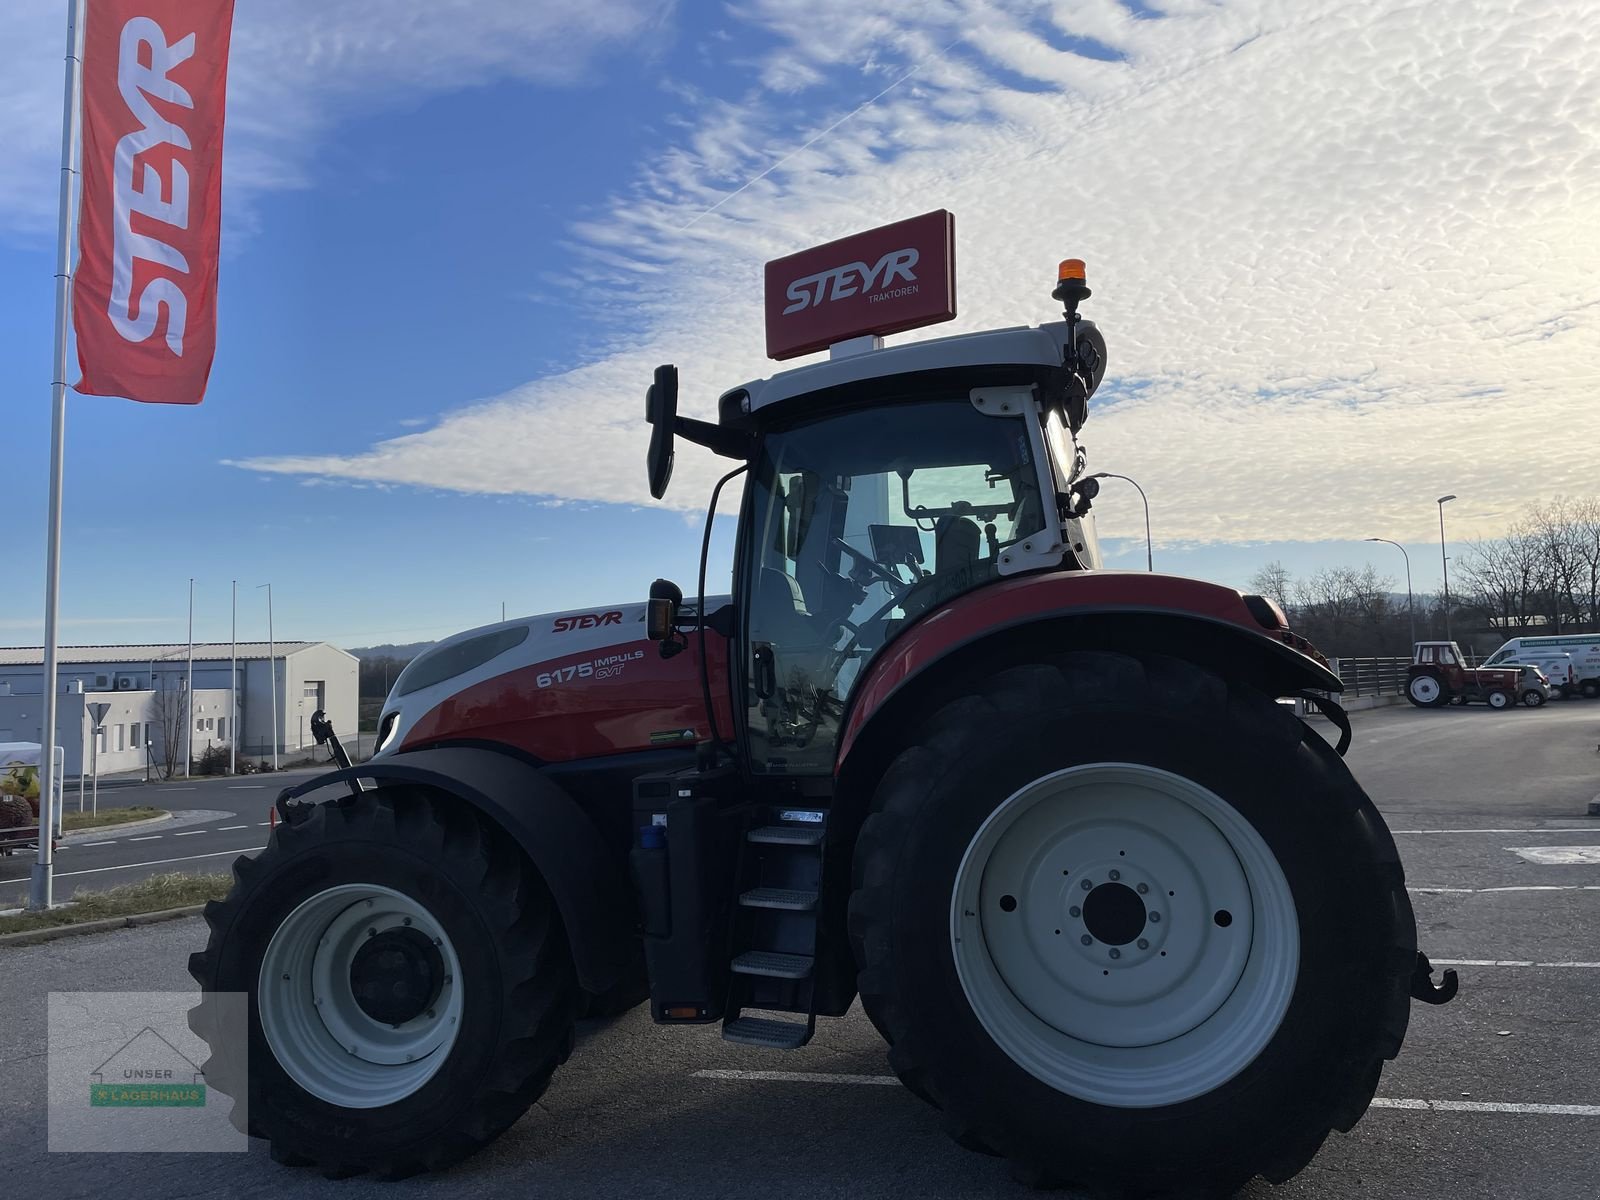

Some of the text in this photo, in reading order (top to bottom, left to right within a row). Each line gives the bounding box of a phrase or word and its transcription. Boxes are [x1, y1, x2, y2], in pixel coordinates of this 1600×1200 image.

[108, 16, 196, 357] STEYR
[782, 247, 920, 316] STEYR
[868, 284, 919, 304] TRAKTOREN
[551, 610, 623, 633] STEYR
[536, 650, 645, 688] 6175 IMPULS
[595, 663, 625, 680] CVT
